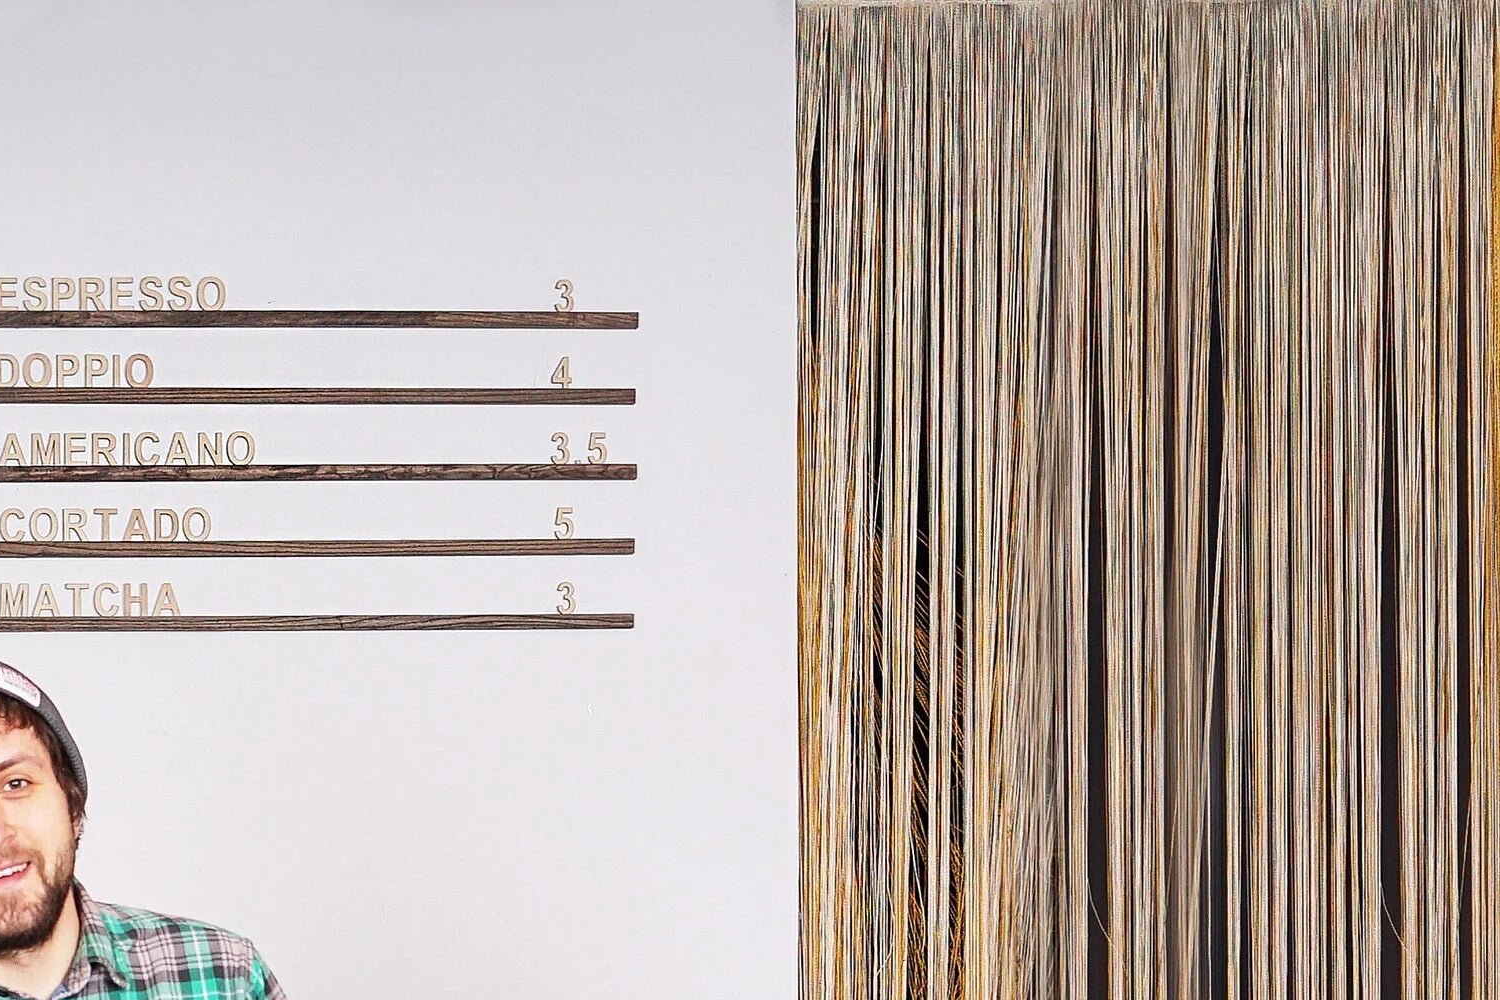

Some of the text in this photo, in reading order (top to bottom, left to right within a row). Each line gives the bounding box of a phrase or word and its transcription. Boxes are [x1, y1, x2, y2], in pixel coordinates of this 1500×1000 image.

[554, 279, 575, 312] 3
[551, 357, 572, 389] 4
[550, 432, 608, 465] 3.5
[0, 507, 575, 541] CORTADO 5
[0, 581, 577, 616] MATCHA 3
